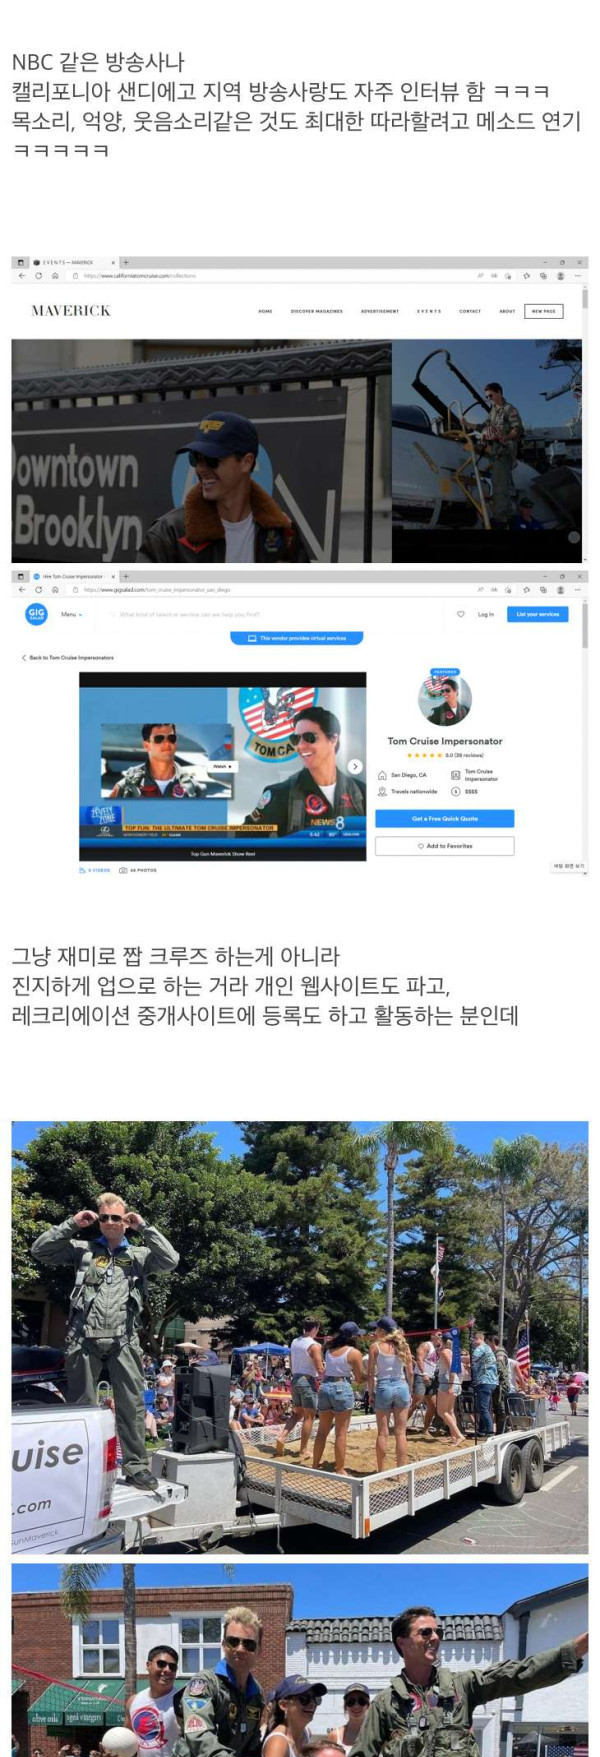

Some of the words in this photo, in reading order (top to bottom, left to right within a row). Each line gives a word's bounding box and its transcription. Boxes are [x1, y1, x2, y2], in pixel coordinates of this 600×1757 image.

[32, 304, 110, 317] MAVERICK
[12, 443, 138, 488] owntown
[15, 494, 142, 562] Brooklyn
[388, 736, 407, 747] Tom
[409, 736, 439, 747] Cruise
[441, 736, 503, 747] Impersonator
[310, 818, 335, 826] NEWS
[335, 815, 345, 830] 8
[32, 1713, 46, 1723] olive
[47, 1713, 59, 1723] oils
